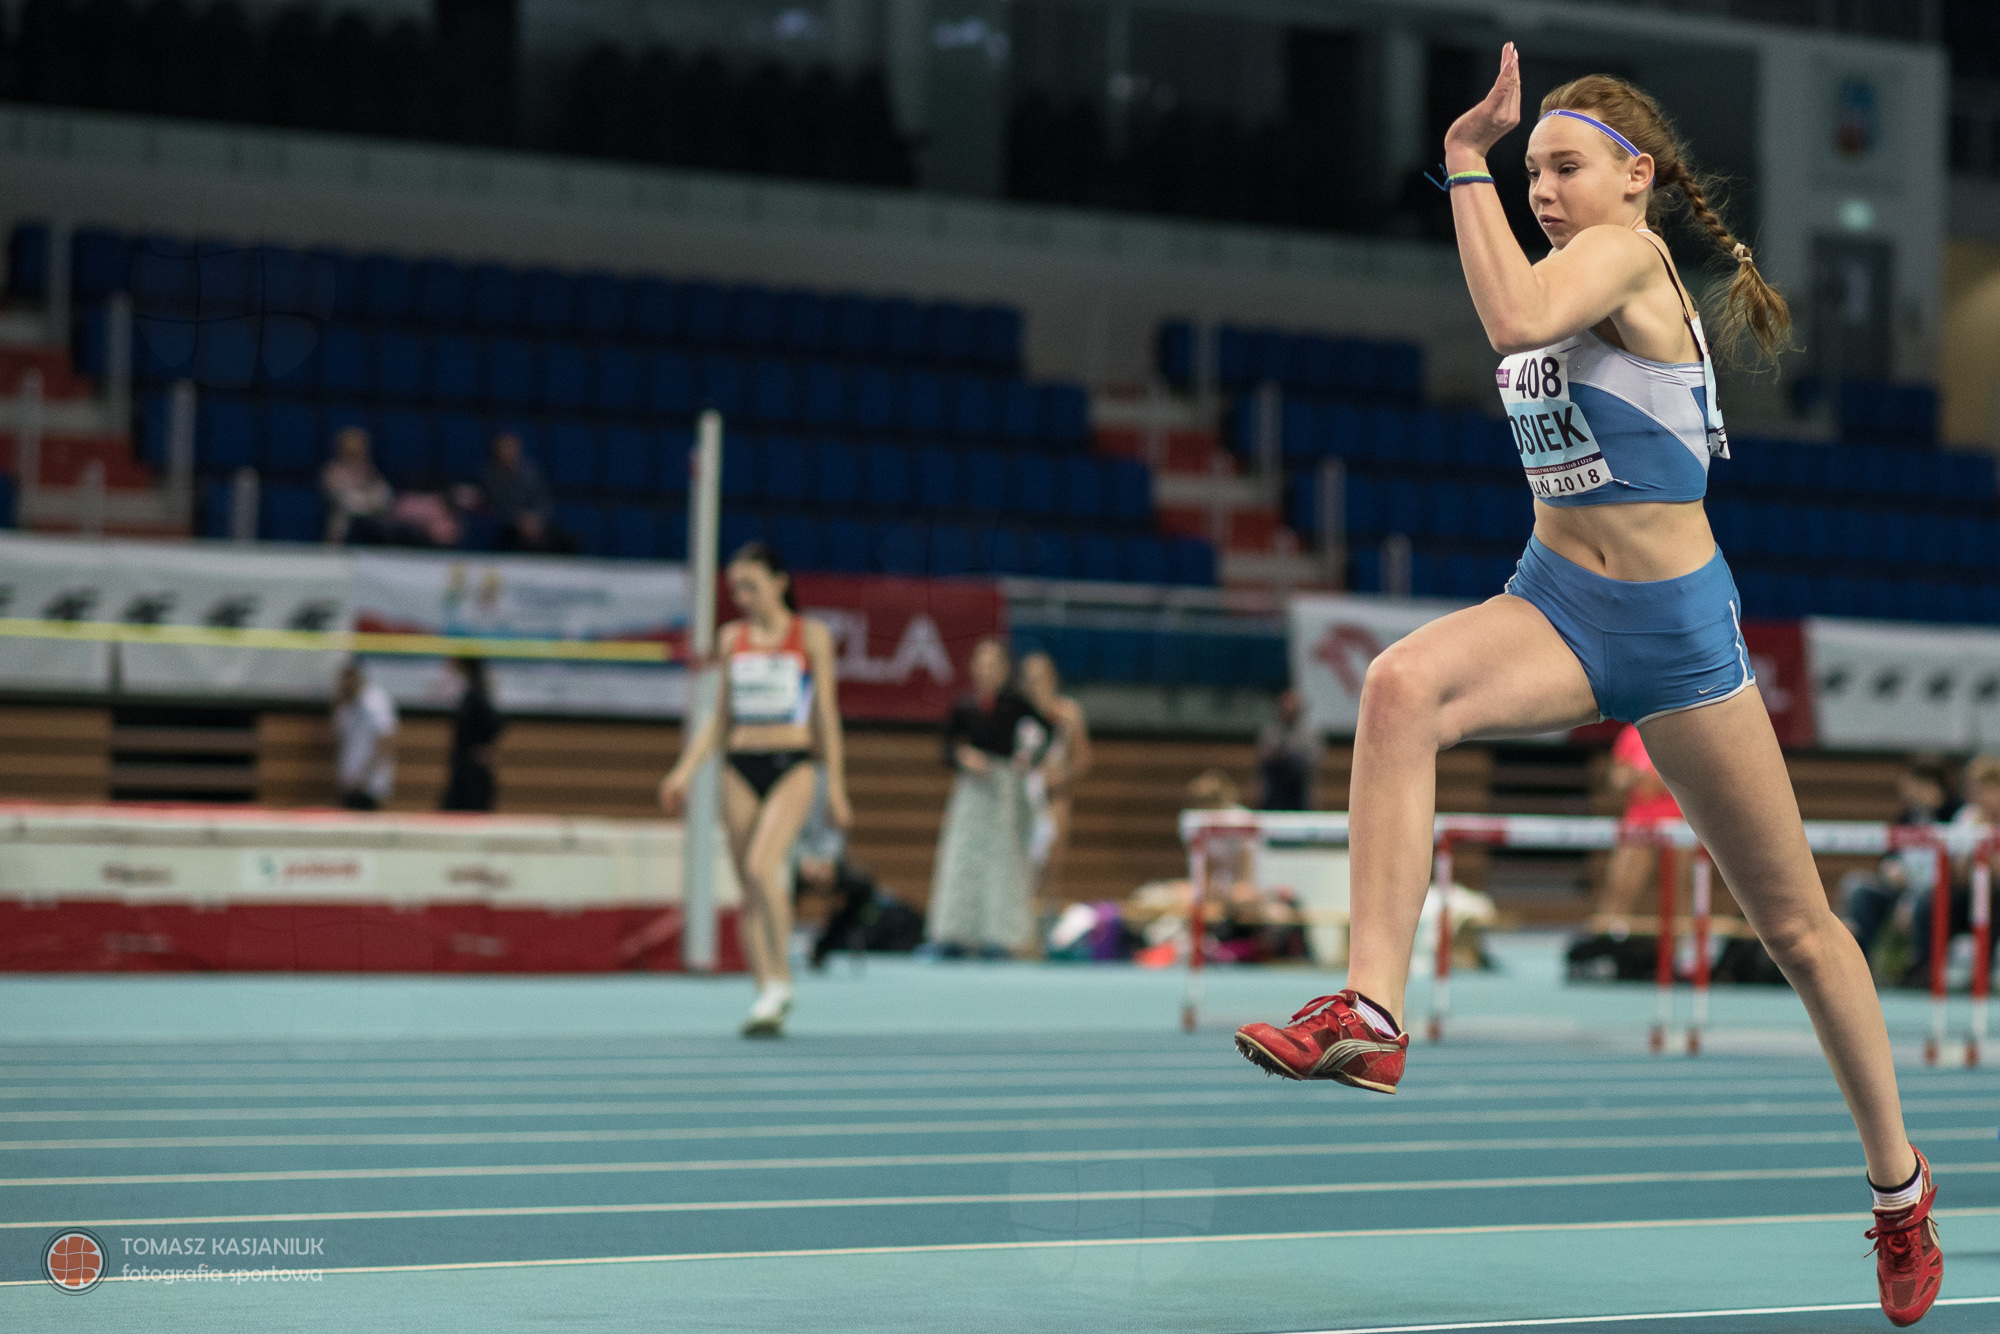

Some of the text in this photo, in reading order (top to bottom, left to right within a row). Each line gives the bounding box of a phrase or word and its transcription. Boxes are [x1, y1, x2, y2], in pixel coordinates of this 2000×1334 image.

[1515, 356, 1562, 399] 408
[1528, 469, 1601, 495] UŃ 2018
[803, 607, 954, 685] ZLA
